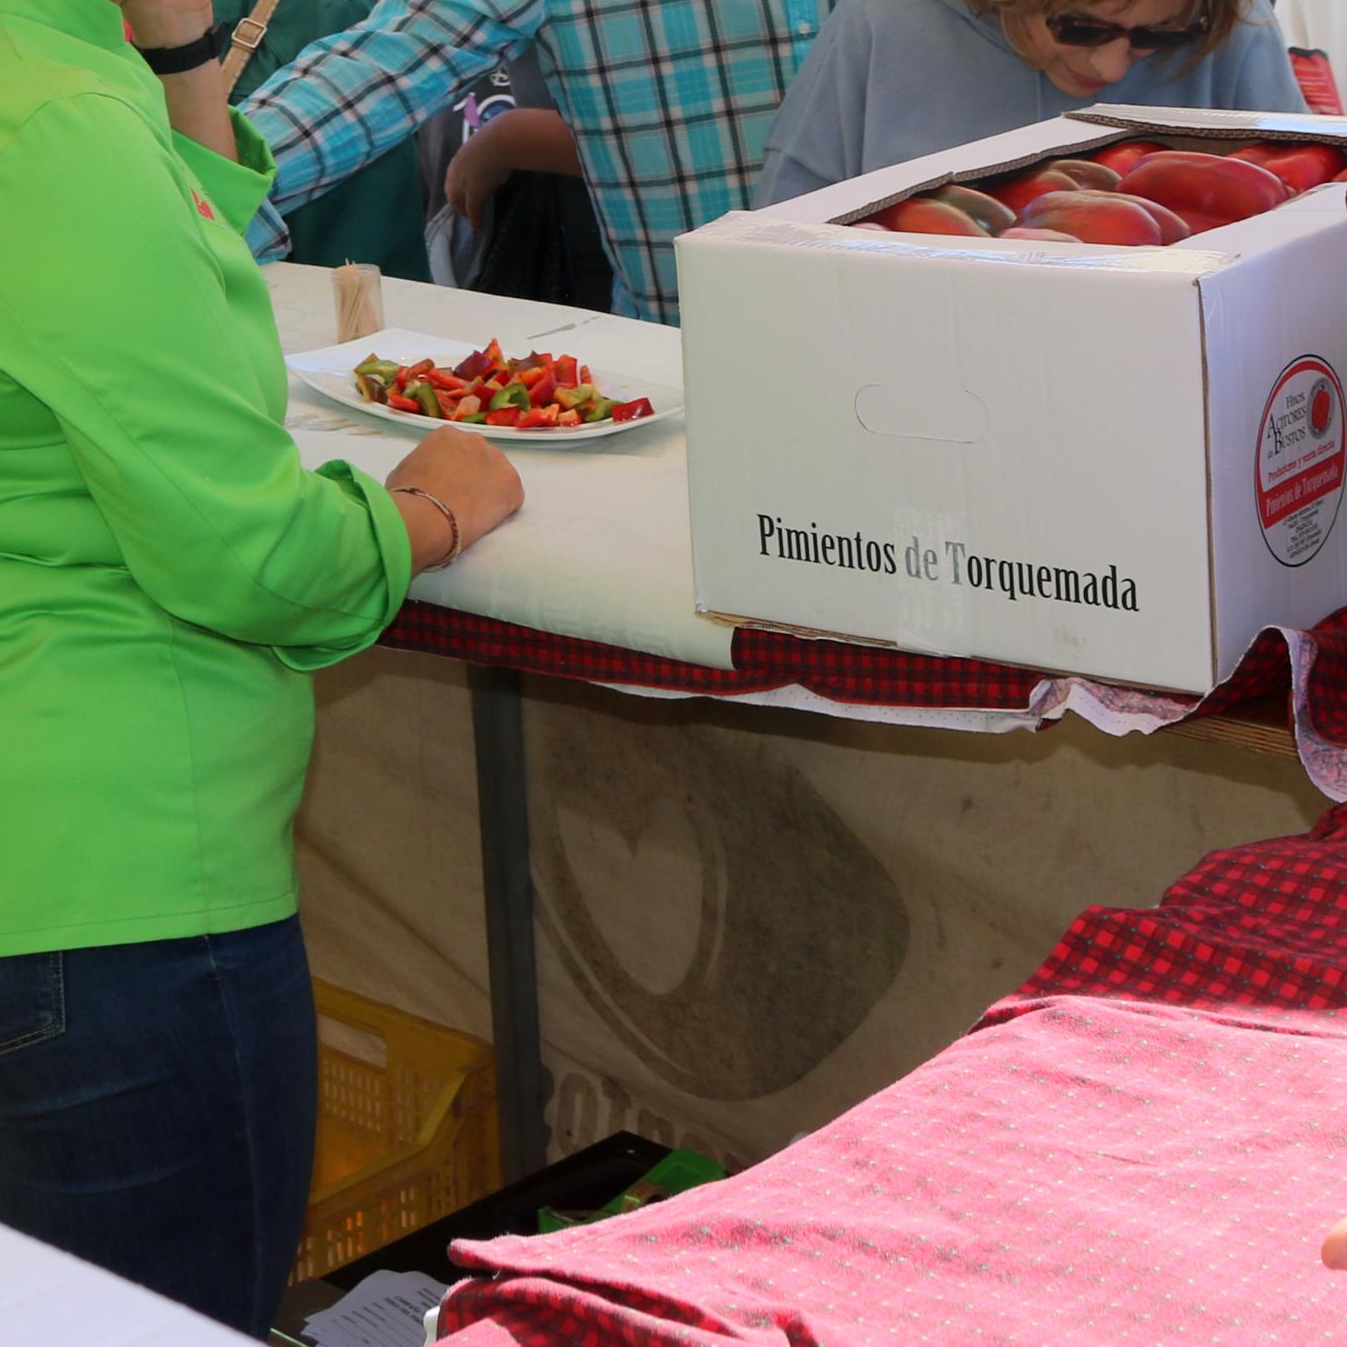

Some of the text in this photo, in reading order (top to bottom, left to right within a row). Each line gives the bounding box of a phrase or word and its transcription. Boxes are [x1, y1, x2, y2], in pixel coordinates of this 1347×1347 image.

[756, 513, 1140, 613] Pimientos de Torquemada
